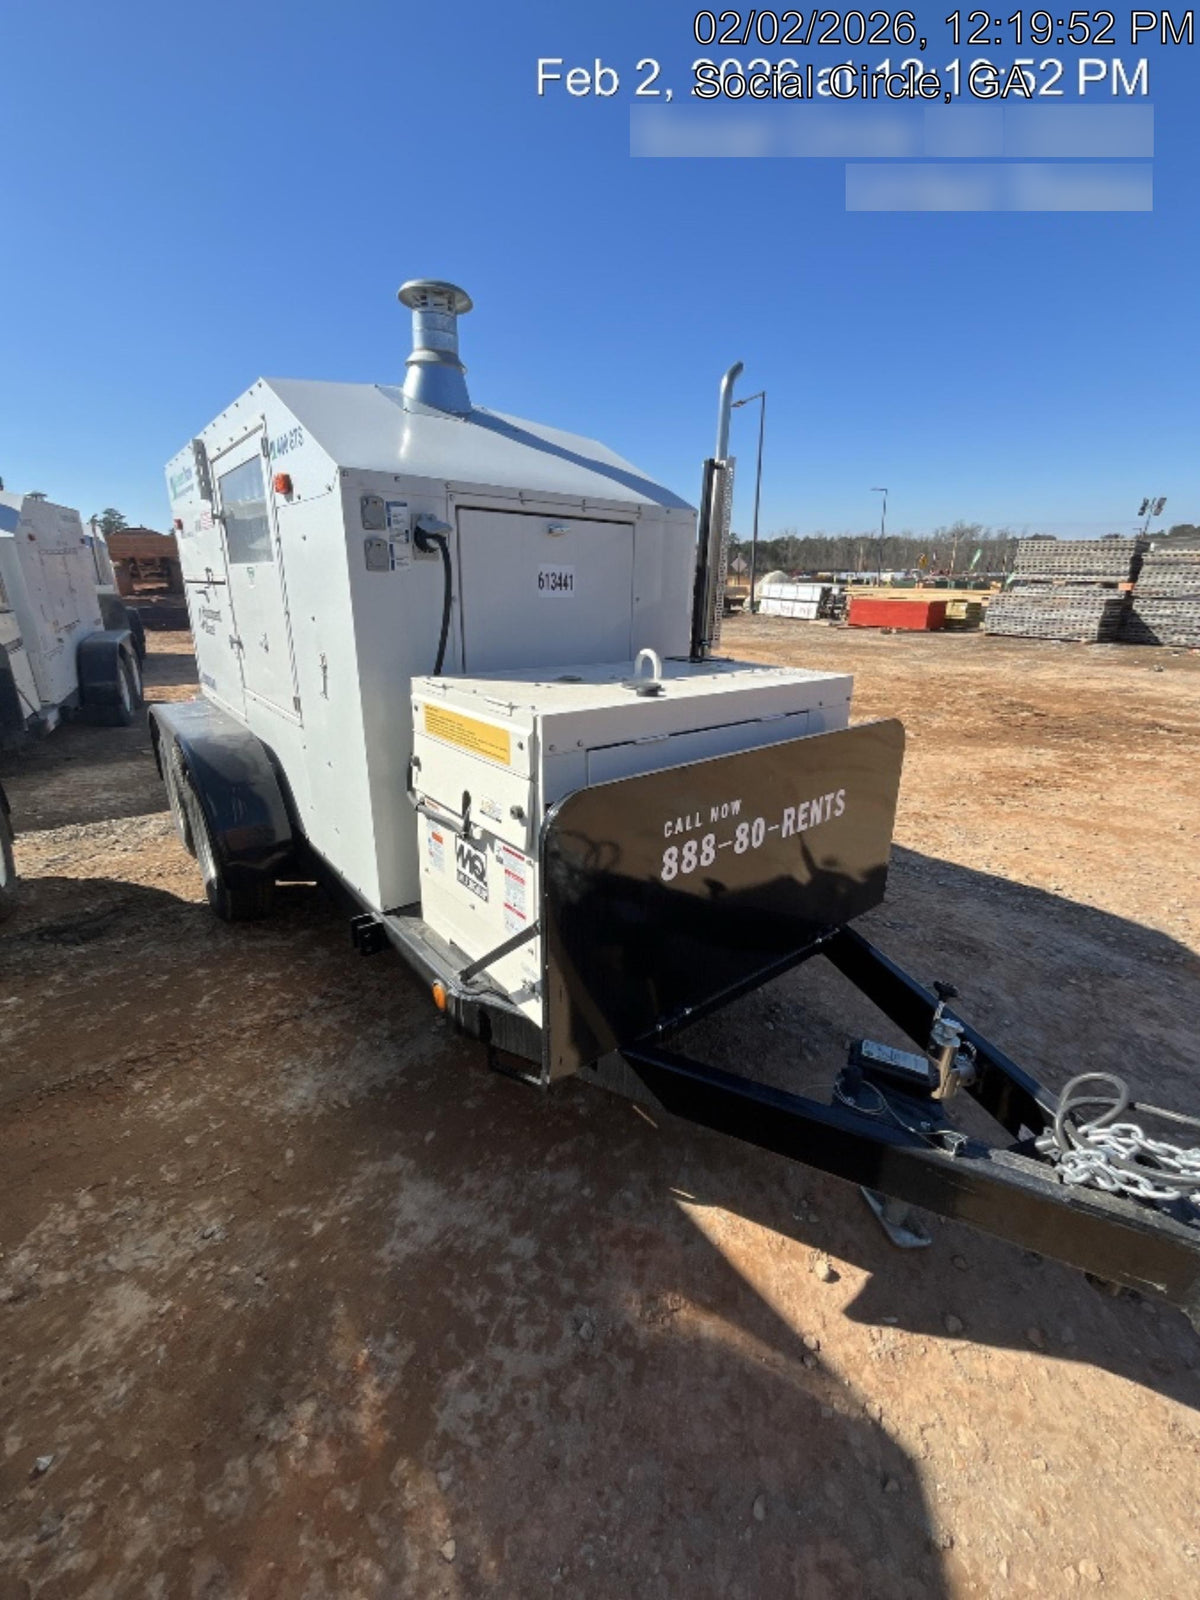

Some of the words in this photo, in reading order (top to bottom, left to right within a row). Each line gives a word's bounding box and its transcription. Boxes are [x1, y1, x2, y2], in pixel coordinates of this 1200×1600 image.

[538, 572, 575, 591] 613441
[660, 788, 847, 882] 888-80-RENTS
[664, 812, 703, 838] CALL
[710, 798, 743, 823] NOW
